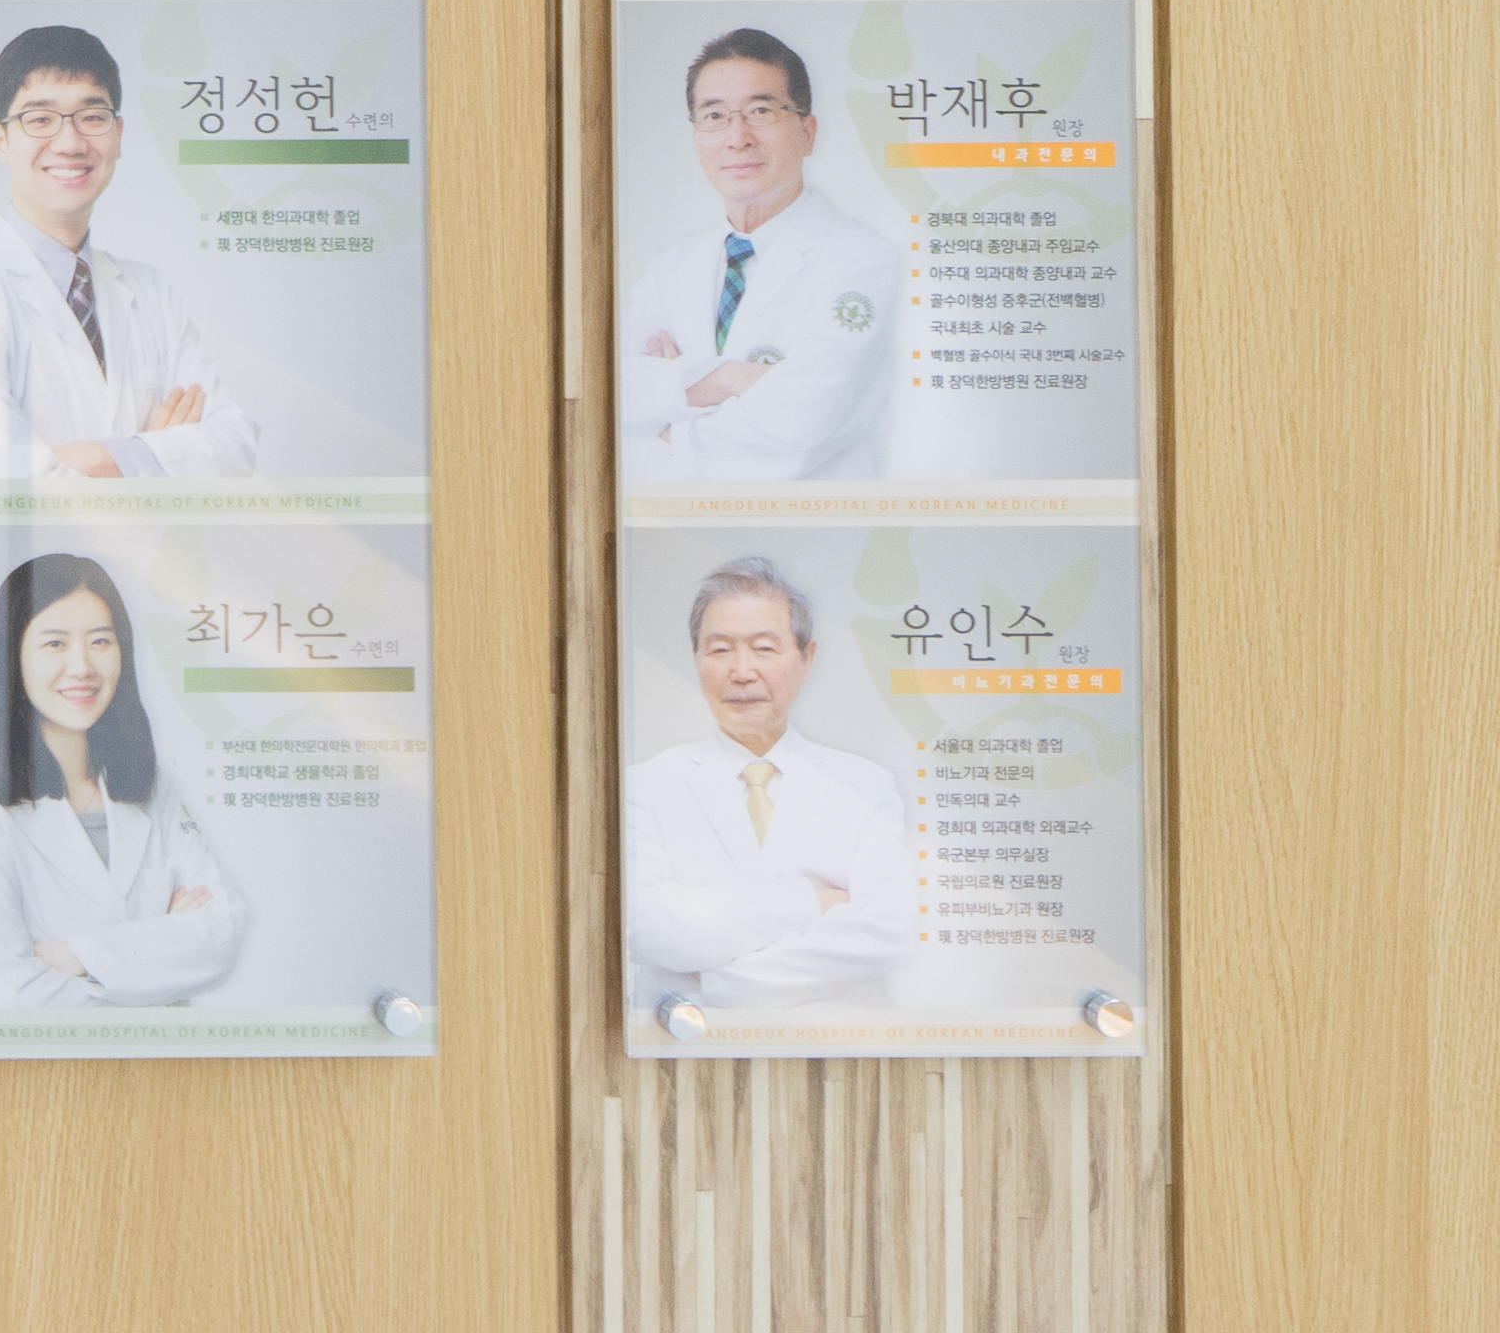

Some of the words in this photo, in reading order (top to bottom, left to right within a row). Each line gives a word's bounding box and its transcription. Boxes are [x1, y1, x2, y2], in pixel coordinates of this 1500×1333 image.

[180, 74, 339, 134] 정성헌
[345, 112, 394, 132] 수련의
[887, 77, 1048, 137] 박재후
[1051, 118, 1085, 138] 원장
[991, 147, 1097, 162] 내과전문의
[216, 210, 258, 226] 세명대
[262, 209, 330, 226] 한의과대학
[334, 209, 360, 226] 졸업
[186, 602, 347, 660] 최가은
[350, 640, 399, 659] 수련의
[890, 604, 1054, 662] 유인수
[1058, 644, 1091, 664] 원장
[952, 674, 1104, 689] 비뇨기과전문의
[935, 766, 990, 782] 비뇨기과
[993, 765, 1035, 782] 전문의
